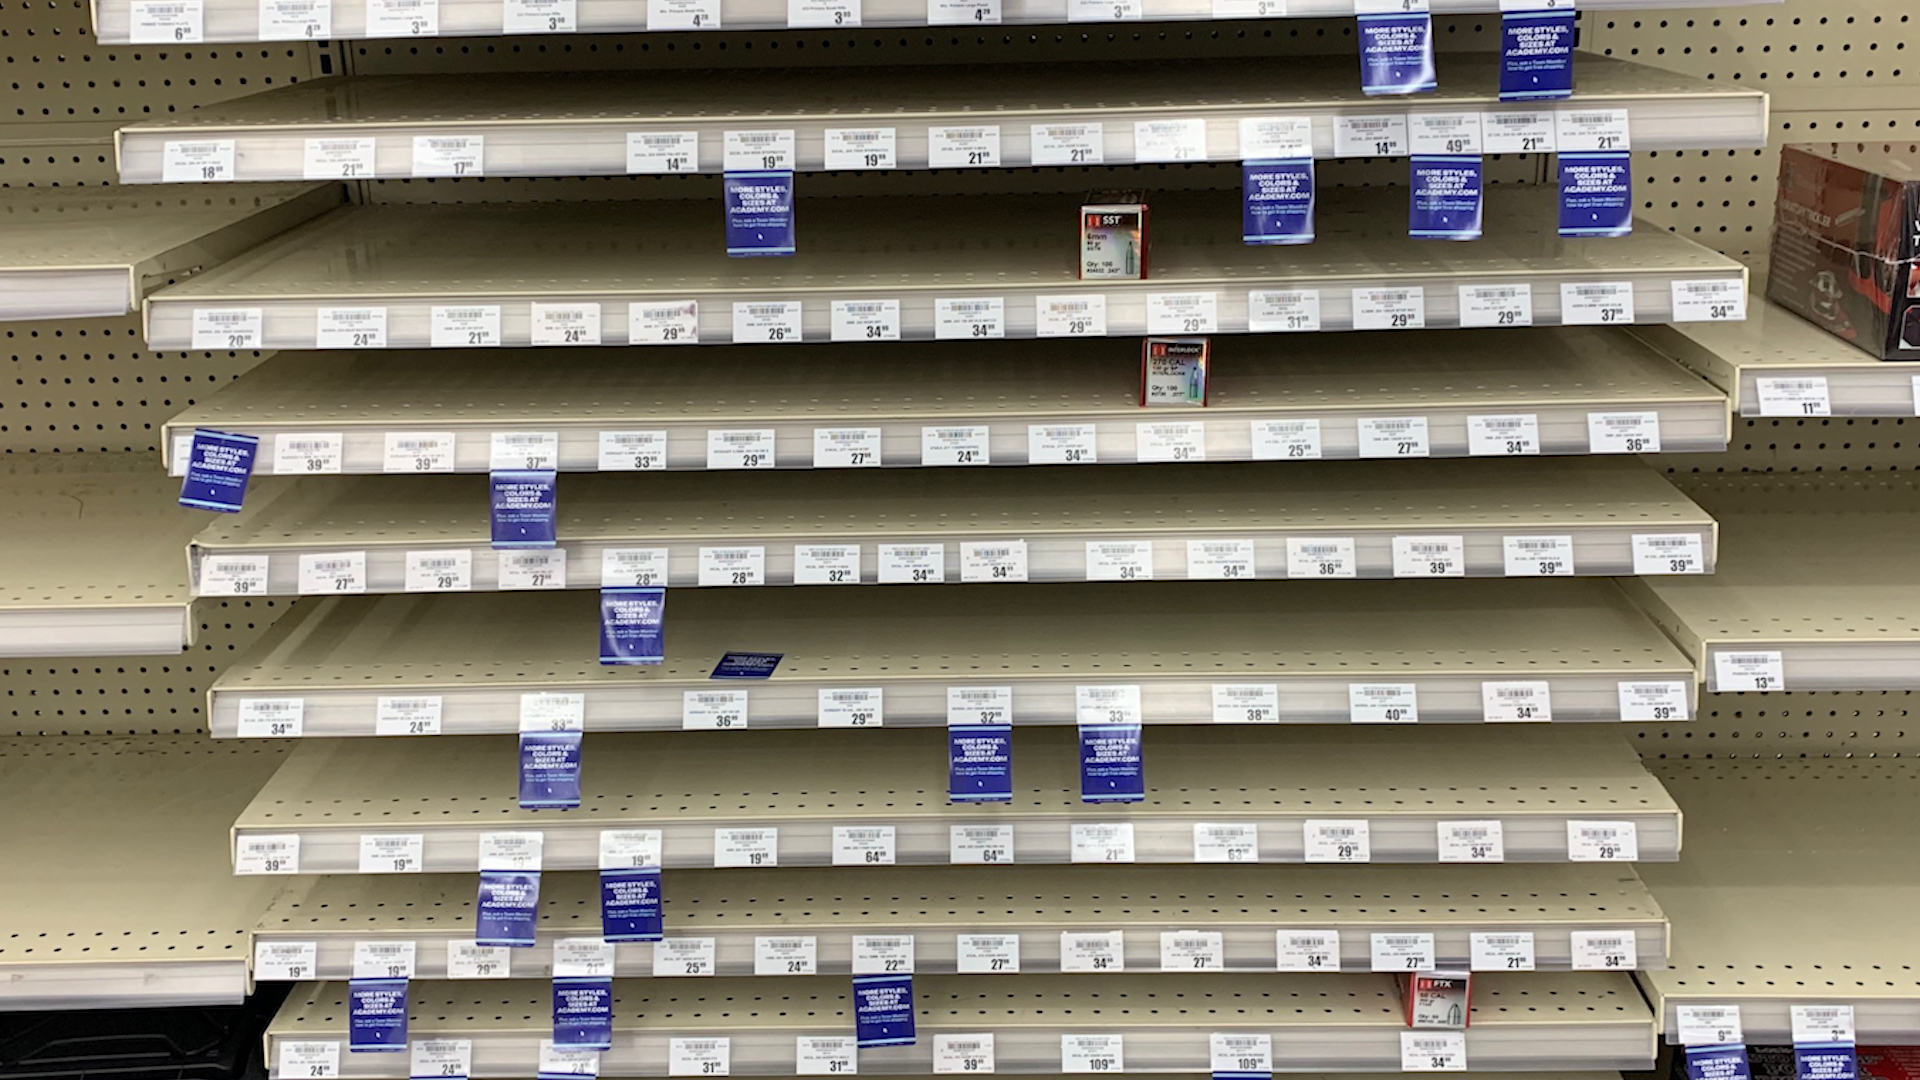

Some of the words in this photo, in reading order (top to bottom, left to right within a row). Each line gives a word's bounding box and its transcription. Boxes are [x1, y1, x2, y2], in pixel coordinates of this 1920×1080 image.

[1508, 26, 1533, 35] MORE
[1517, 33, 1552, 41] COLORS
[1519, 40, 1544, 48] SIZES
[1505, 46, 1569, 56] ACADEMY.COM
[1417, 168, 1442, 176] MORE
[1250, 173, 1274, 181] MORE
[1415, 188, 1477, 197] ACADEMY.COM
[1564, 185, 1627, 193] ACADEMY.COM
[1249, 192, 1309, 200] ACADEMY.COM
[1103, 215, 1120, 224] SST
[1169, 357, 1186, 365] CAL
[495, 483, 518, 491] MORE
[954, 737, 975, 745] MORE
[605, 898, 658, 906] ACADEMY.COM
[858, 988, 878, 996] MORE
[858, 1004, 910, 1012] ACADEMY.COM
